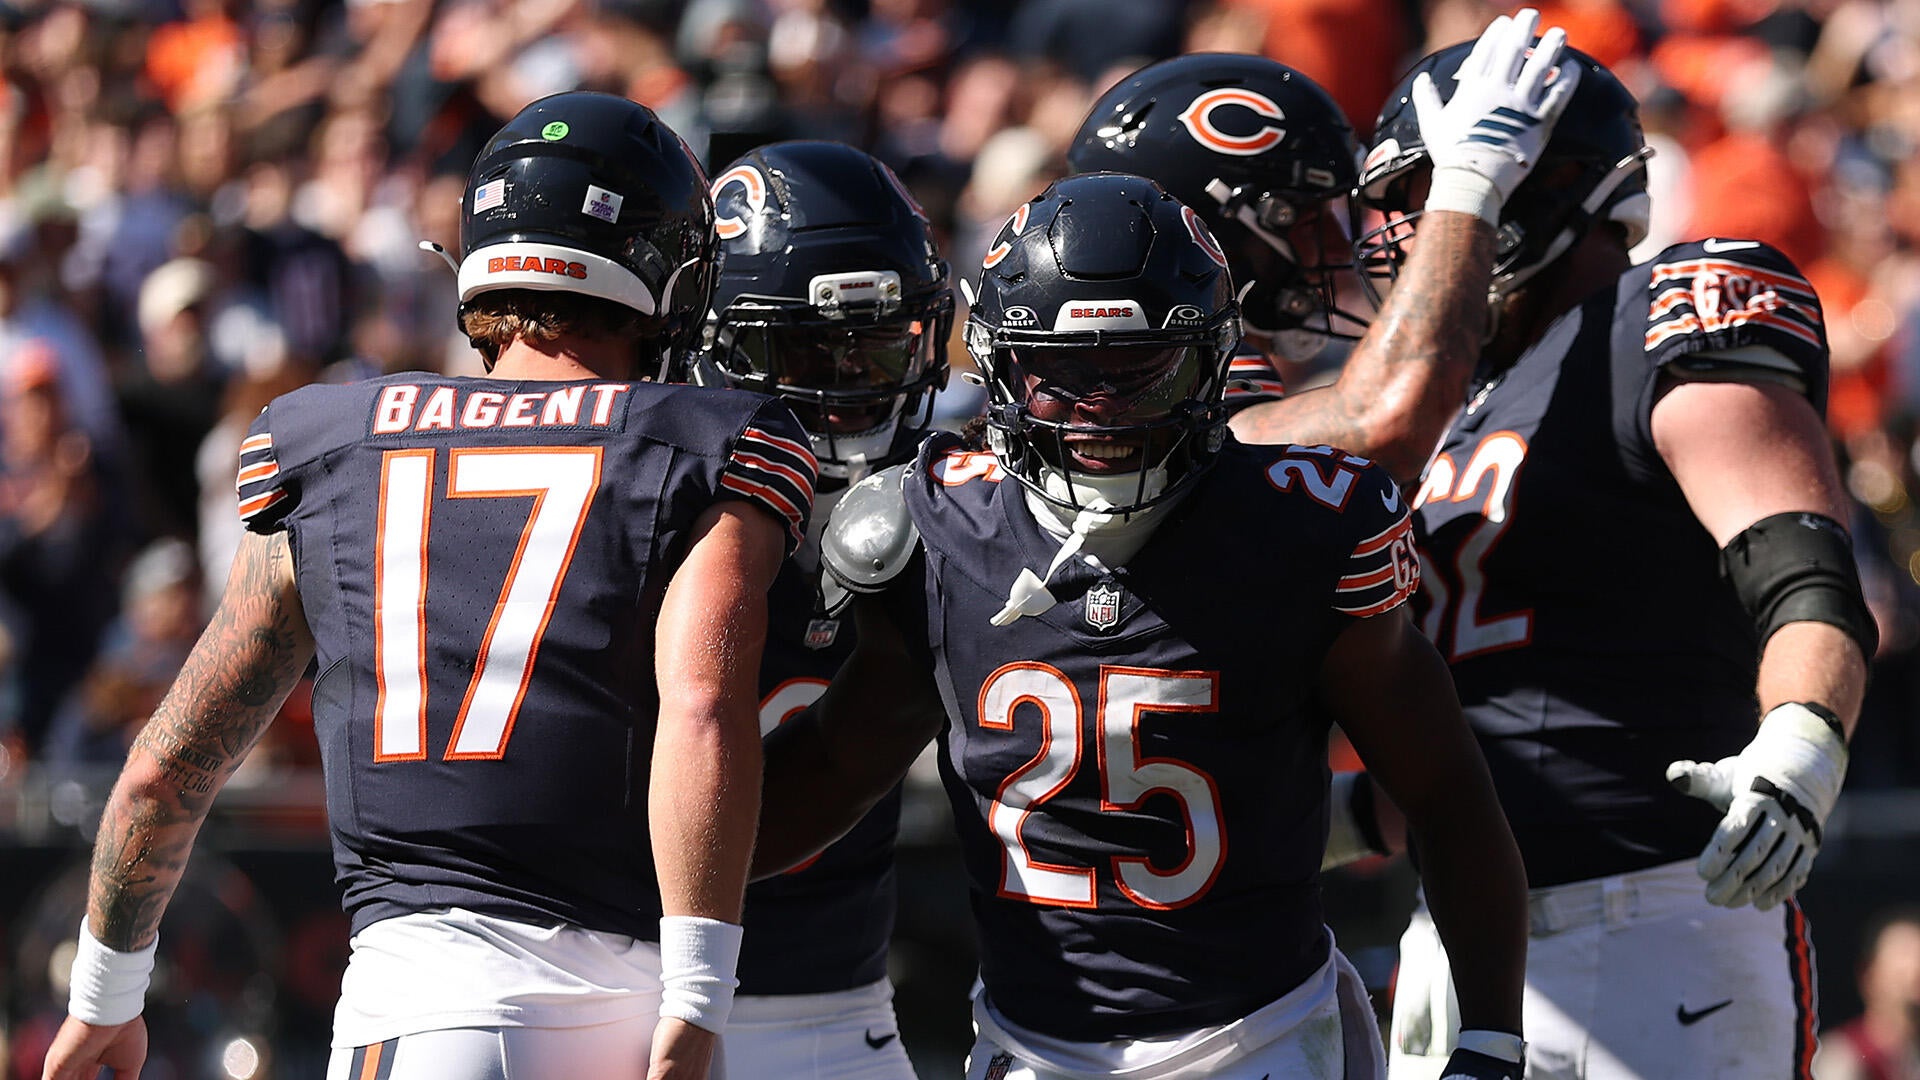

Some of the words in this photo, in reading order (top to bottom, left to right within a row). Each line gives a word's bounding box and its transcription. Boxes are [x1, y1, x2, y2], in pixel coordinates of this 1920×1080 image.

[488, 255, 588, 280] BEARS
[1002, 319, 1036, 327] OAKLEY
[1070, 307, 1134, 318] BEARS
[373, 384, 630, 435] BAGENT
[374, 446, 605, 763] 17
[1090, 605, 1115, 623] NFL
[977, 660, 1228, 911] 25
